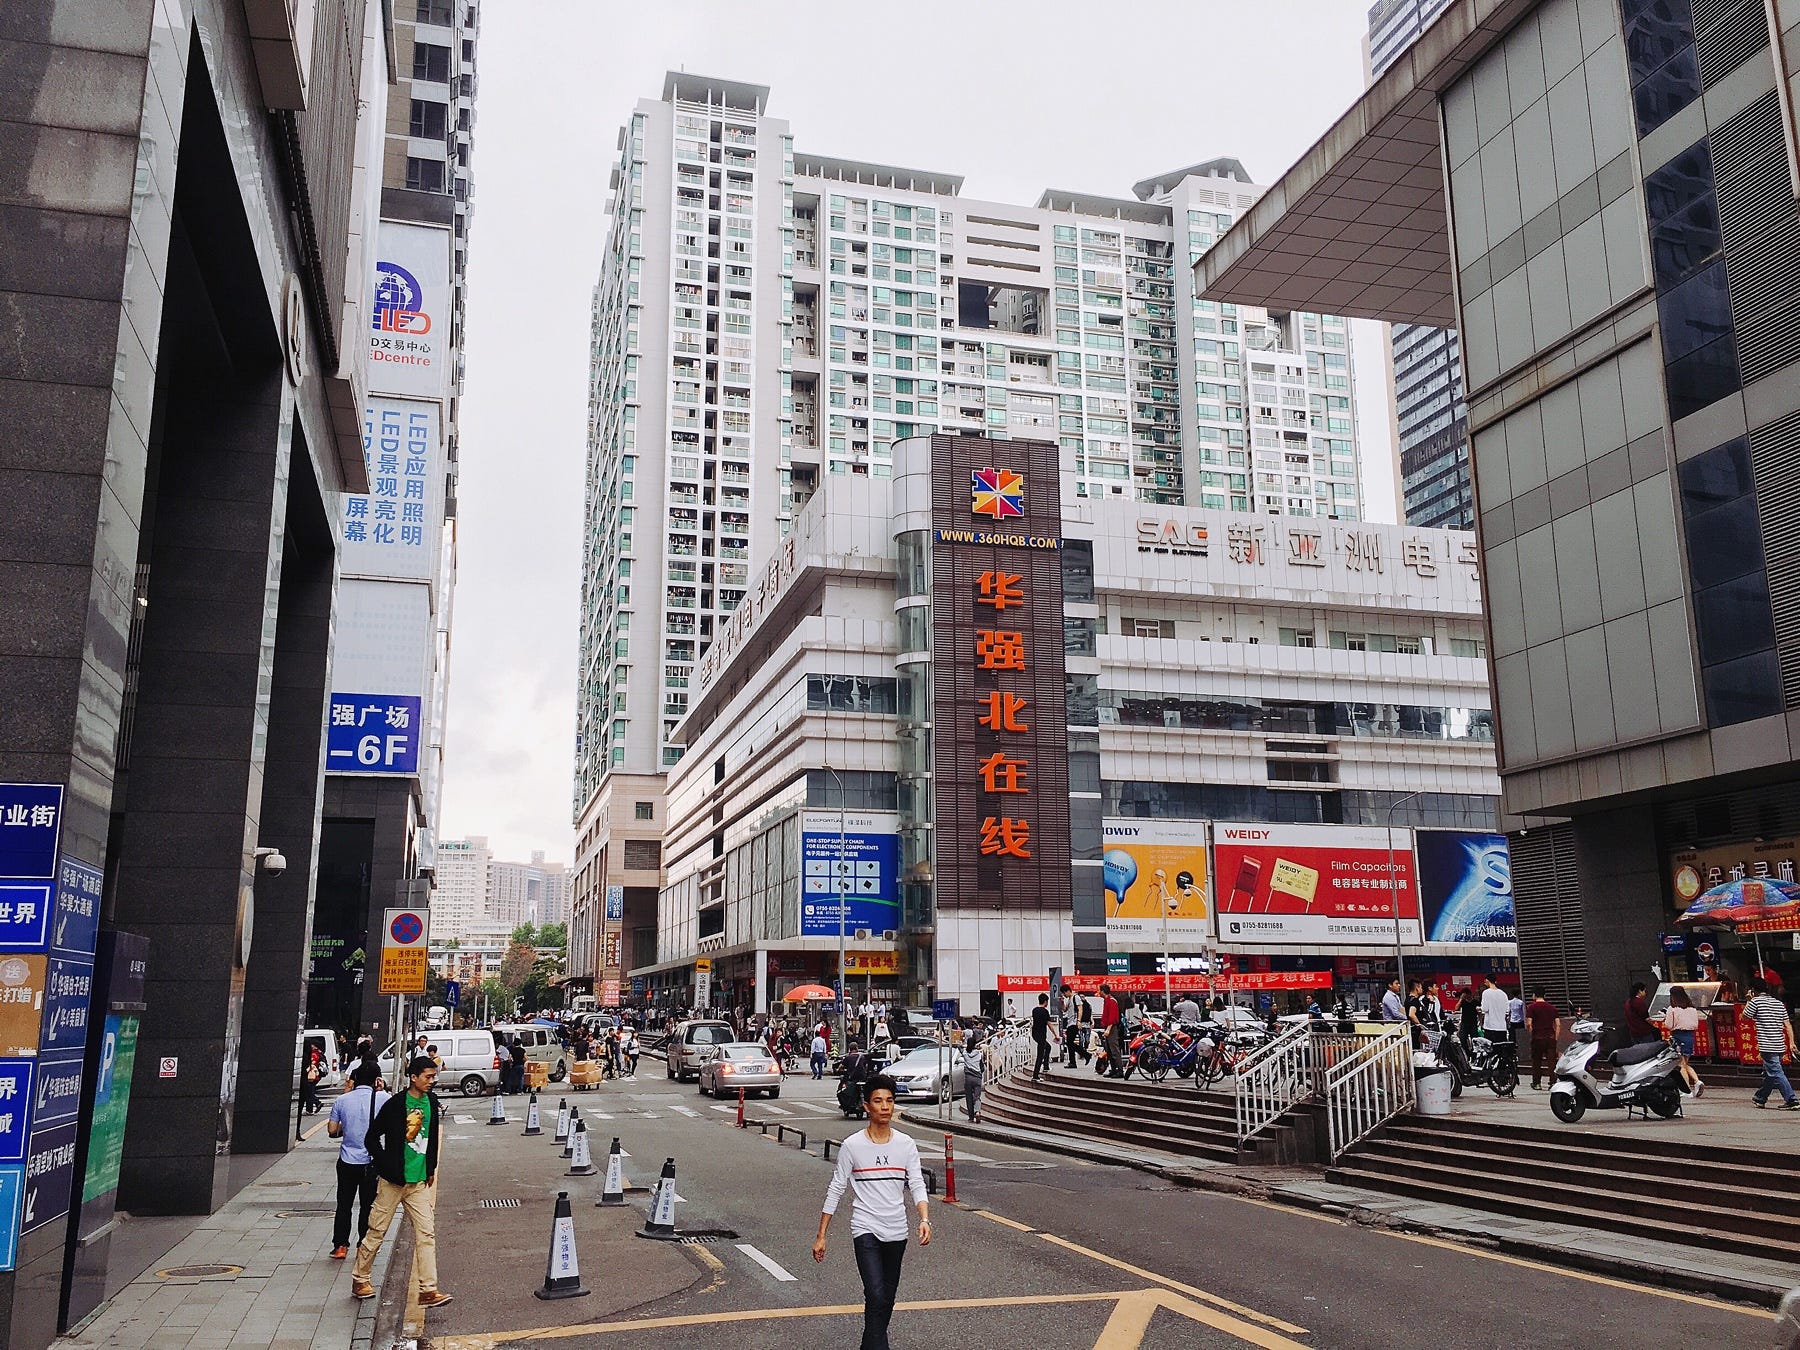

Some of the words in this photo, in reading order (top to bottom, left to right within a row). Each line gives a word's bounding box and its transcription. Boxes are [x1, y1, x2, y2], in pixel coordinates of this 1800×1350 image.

[381, 307, 431, 335] LED
[940, 529, 1058, 549] WWW.360HQB.COM
[332, 703, 410, 729] 强广场
[975, 571, 1032, 858] 华强北在线
[0, 803, 56, 828] 业街
[1225, 829, 1271, 840] WEIDY
[1279, 863, 1301, 875] WEIDY
[1331, 860, 1350, 871] Film
[0, 986, 33, 1003] 打蜡
